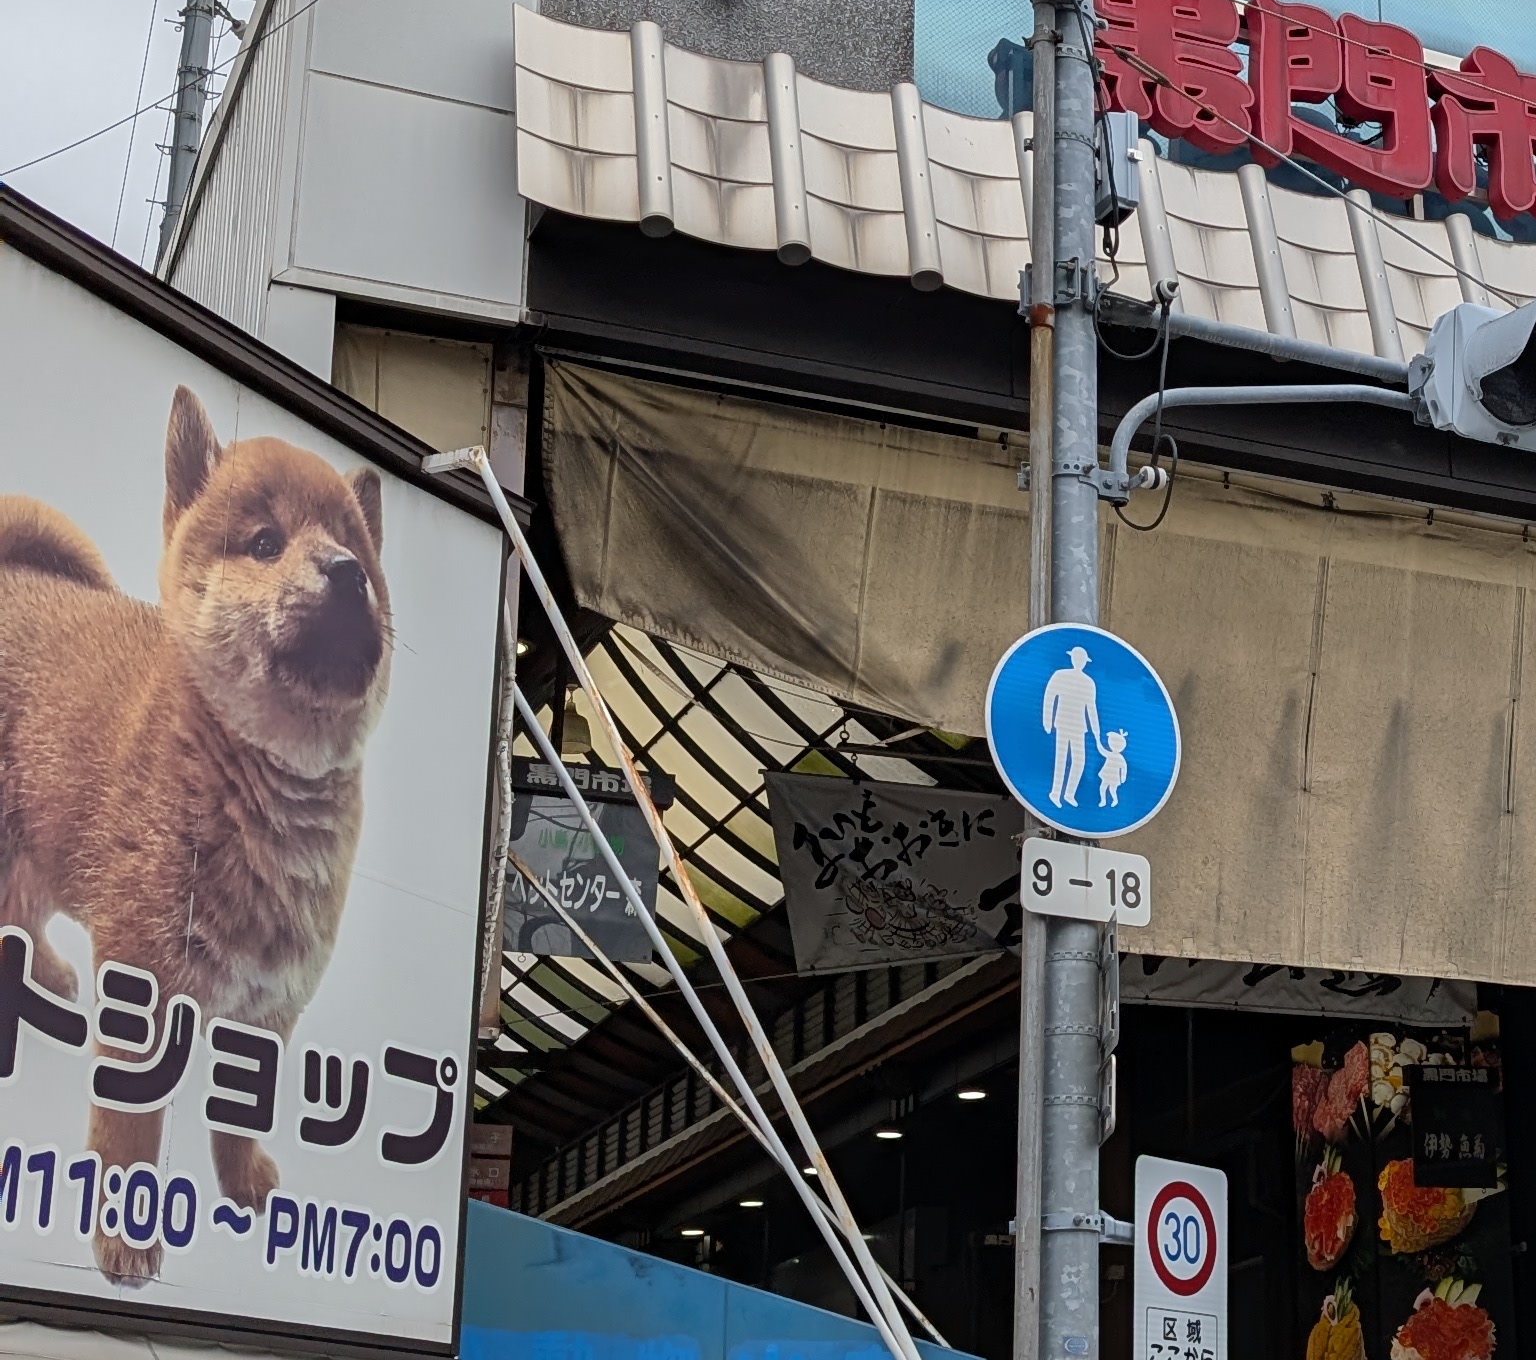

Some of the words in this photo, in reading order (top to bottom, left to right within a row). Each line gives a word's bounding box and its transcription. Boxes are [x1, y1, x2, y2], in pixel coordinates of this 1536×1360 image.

[0, 926, 459, 1167] トショップ
[1423, 1067, 1489, 1083] 黒門市場
[1163, 1211, 1201, 1265] 30
[1162, 1316, 1203, 1345] 区域
